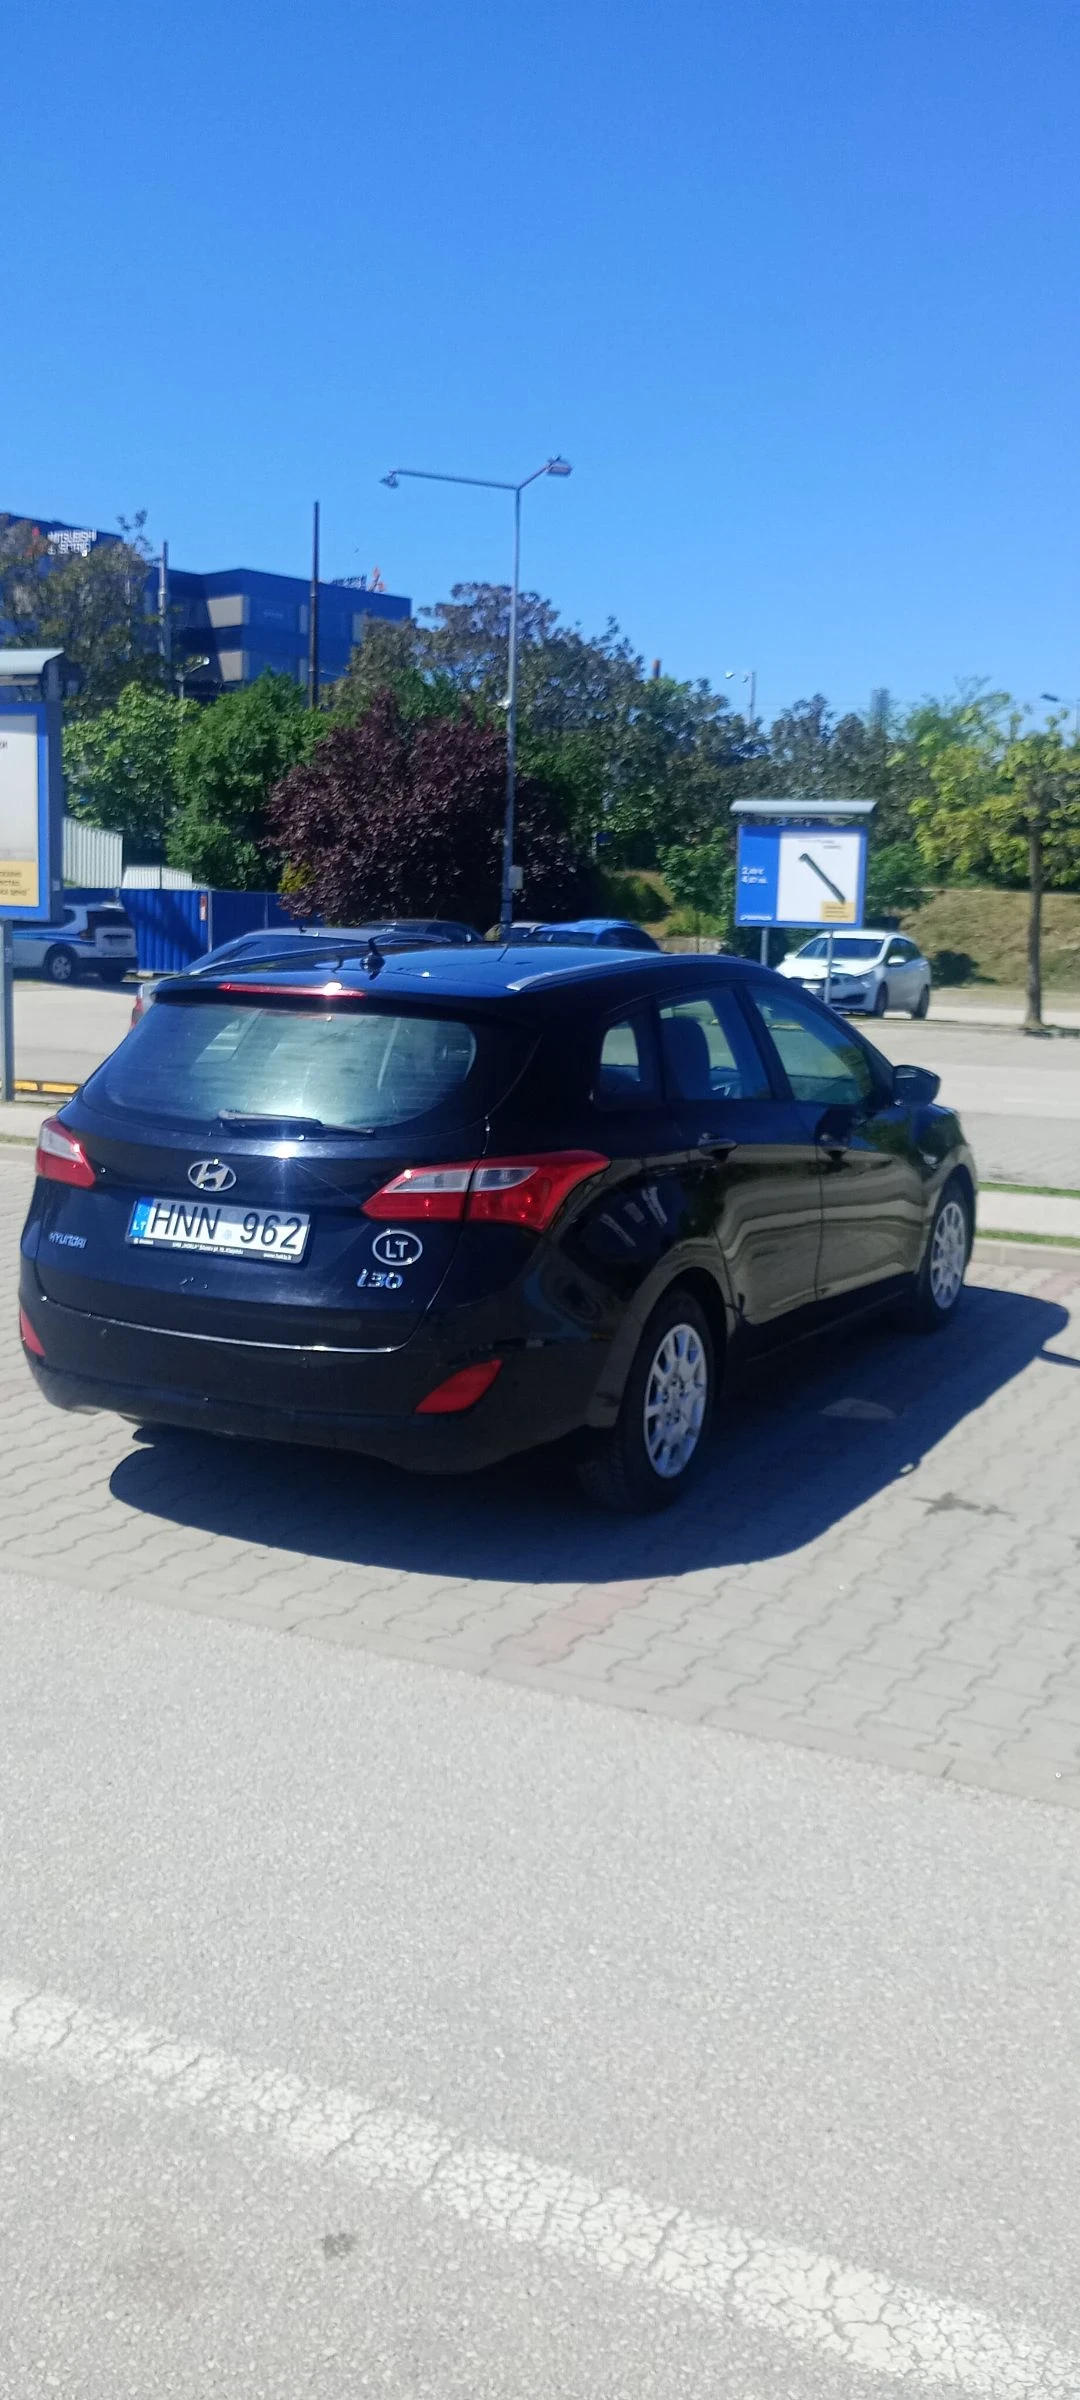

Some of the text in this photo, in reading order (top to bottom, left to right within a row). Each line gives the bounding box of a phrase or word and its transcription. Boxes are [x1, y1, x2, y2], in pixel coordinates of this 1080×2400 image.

[133, 1219, 147, 1231] LT
[150, 1203, 302, 1249] HNN 962
[385, 1240, 409, 1258] LT
[356, 1268, 404, 1290] i30
